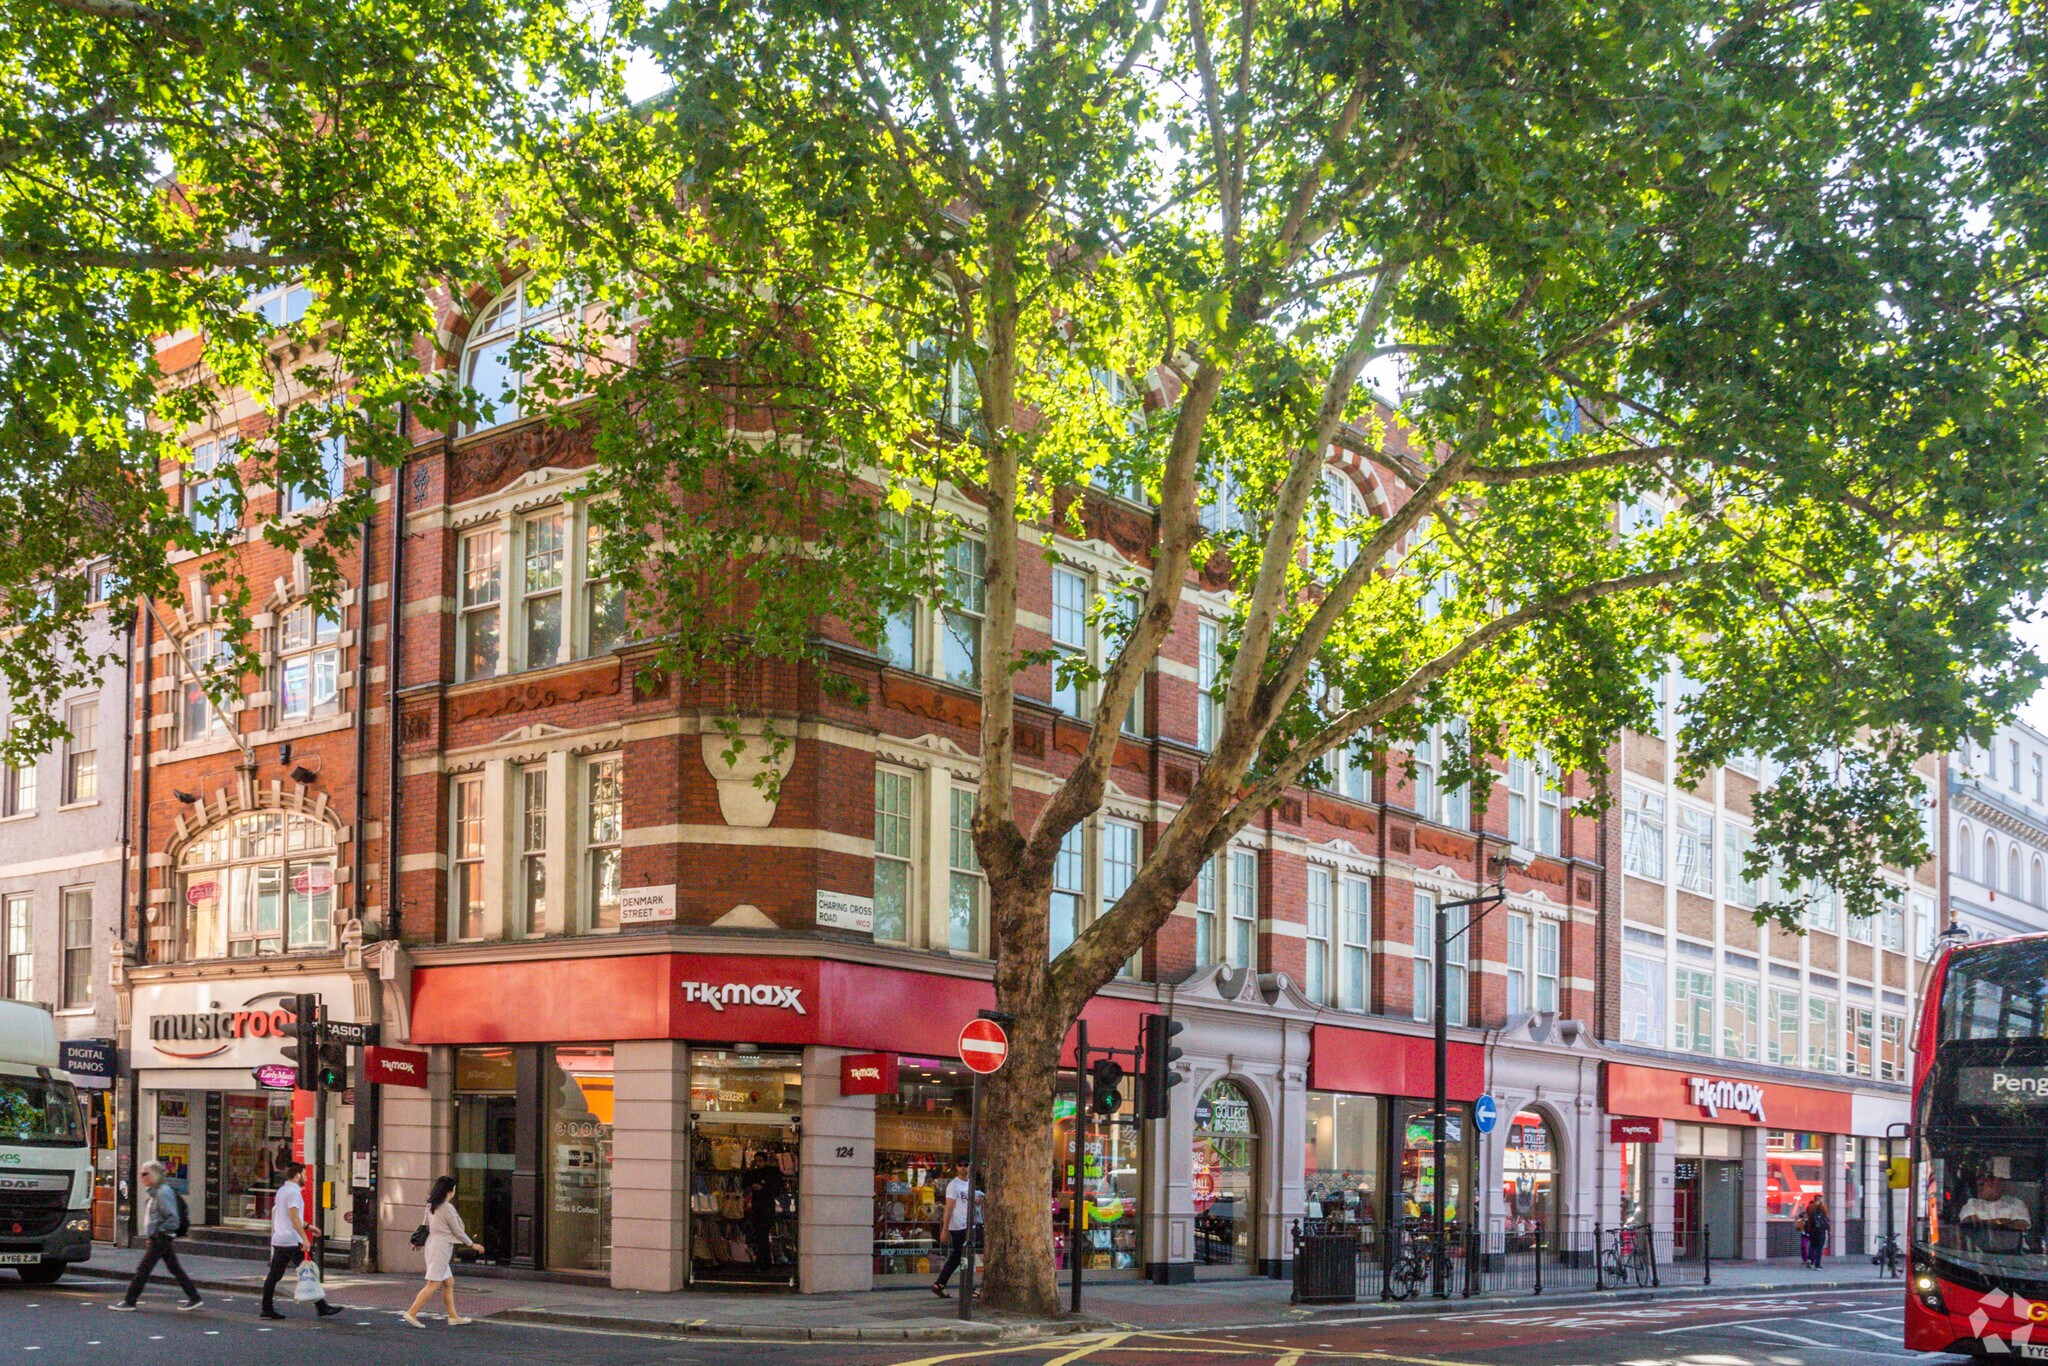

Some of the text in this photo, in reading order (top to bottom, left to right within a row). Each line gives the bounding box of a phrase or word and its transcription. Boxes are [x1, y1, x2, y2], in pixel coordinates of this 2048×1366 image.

[622, 895, 664, 907] DENMARK
[622, 908, 673, 919] STREET WC2
[818, 900, 872, 916] CHARING CROSS
[818, 912, 838, 922] ROAD
[856, 920, 871, 928] WC2
[149, 1001, 319, 1040] musicroo
[68, 1047, 104, 1060] DIGITAL
[68, 1060, 104, 1072] PIANOS
[1215, 1106, 1248, 1120] COLLECT
[1214, 1119, 1248, 1132] IN-STORE
[836, 1146, 854, 1158] 124
[1069, 1141, 1102, 1154] SPER
[1067, 1164, 1103, 1178] BAND
[1, 1180, 39, 1189] DAF
[555, 1204, 599, 1214] Click & Collect
[881, 1248, 896, 1256] SHOP
[2, 1255, 38, 1263] AY66 ZJN
[2026, 1302, 2048, 1322] G
